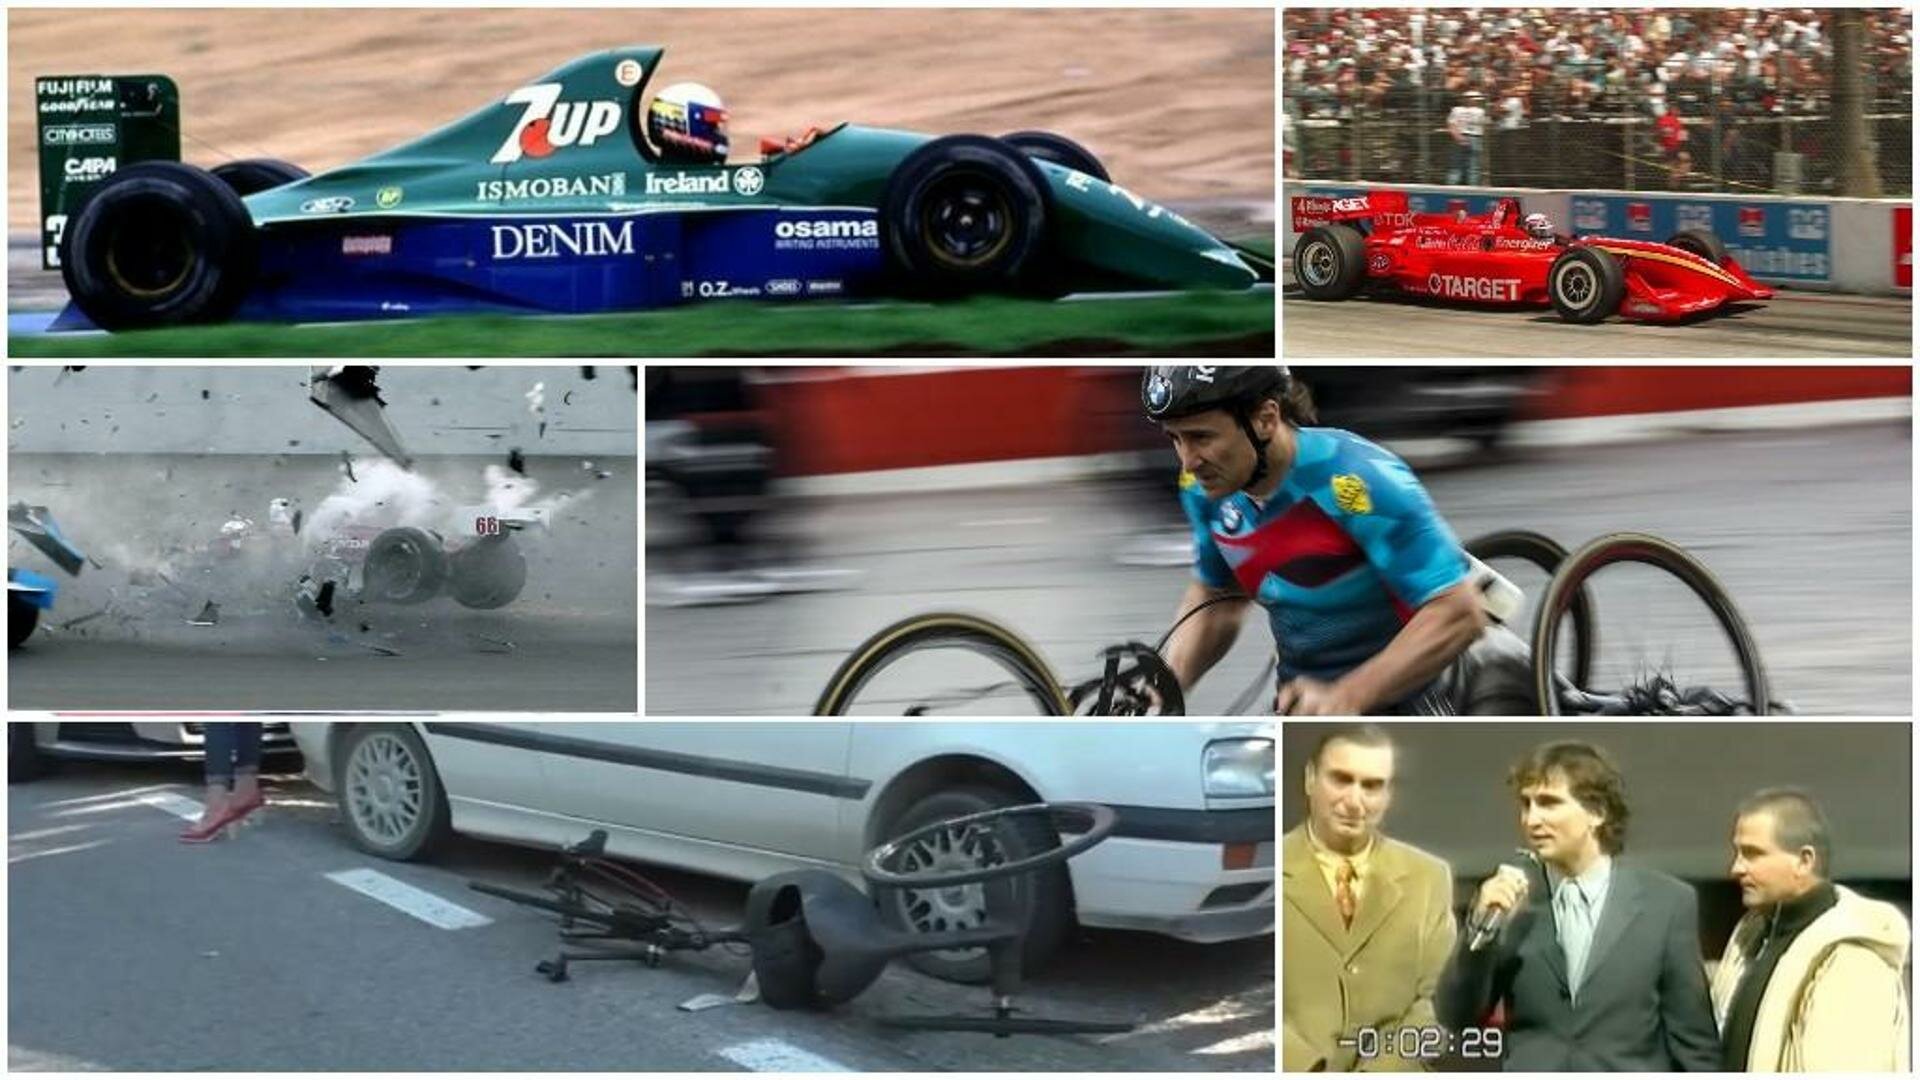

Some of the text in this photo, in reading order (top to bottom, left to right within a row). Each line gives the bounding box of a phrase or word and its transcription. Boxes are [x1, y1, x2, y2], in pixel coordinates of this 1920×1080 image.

[64, 157, 117, 175] CAPA
[645, 169, 730, 195] Ireland
[775, 219, 878, 239] osama
[1383, 212, 1417, 227] TDK
[491, 220, 635, 260] DENIM
[816, 238, 879, 250] INSTRUMENTS
[1441, 275, 1522, 301] TARGET
[476, 516, 498, 535] 66
